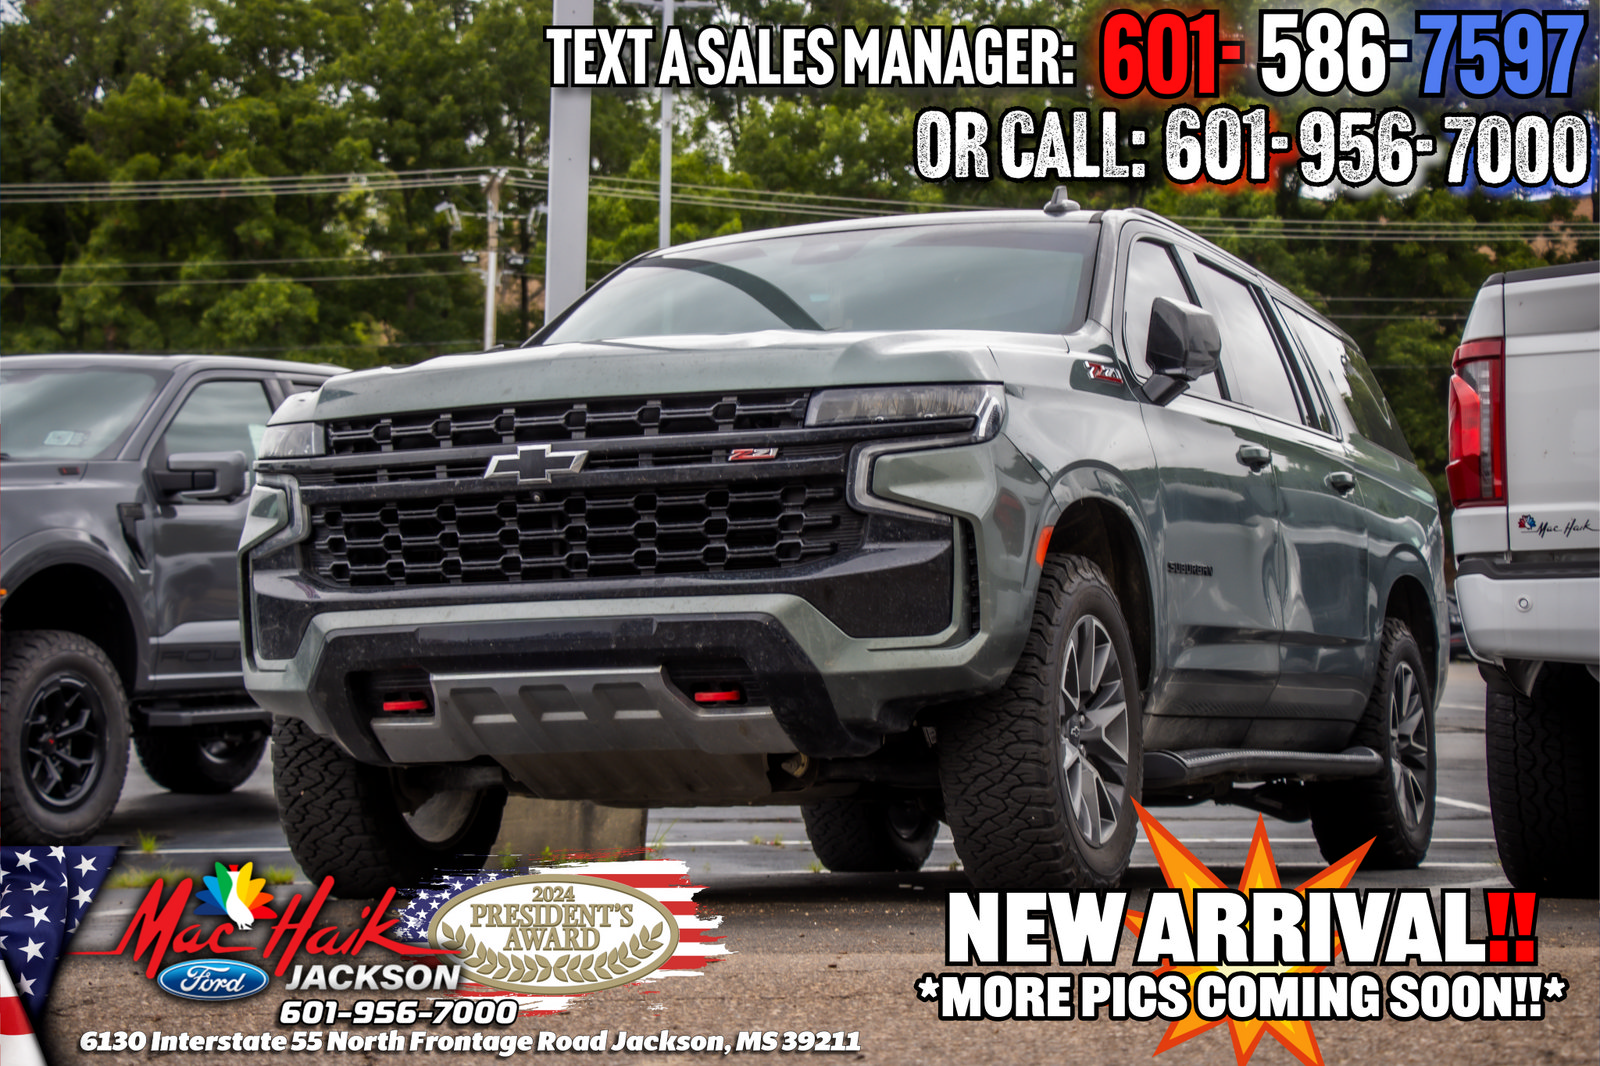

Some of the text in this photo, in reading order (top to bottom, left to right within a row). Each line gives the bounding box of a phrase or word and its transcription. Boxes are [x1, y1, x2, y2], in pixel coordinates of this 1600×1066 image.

[1529, 519, 1562, 538] Mac
[1167, 561, 1213, 577] SUBURBAN
[160, 648, 241, 663] ROU
